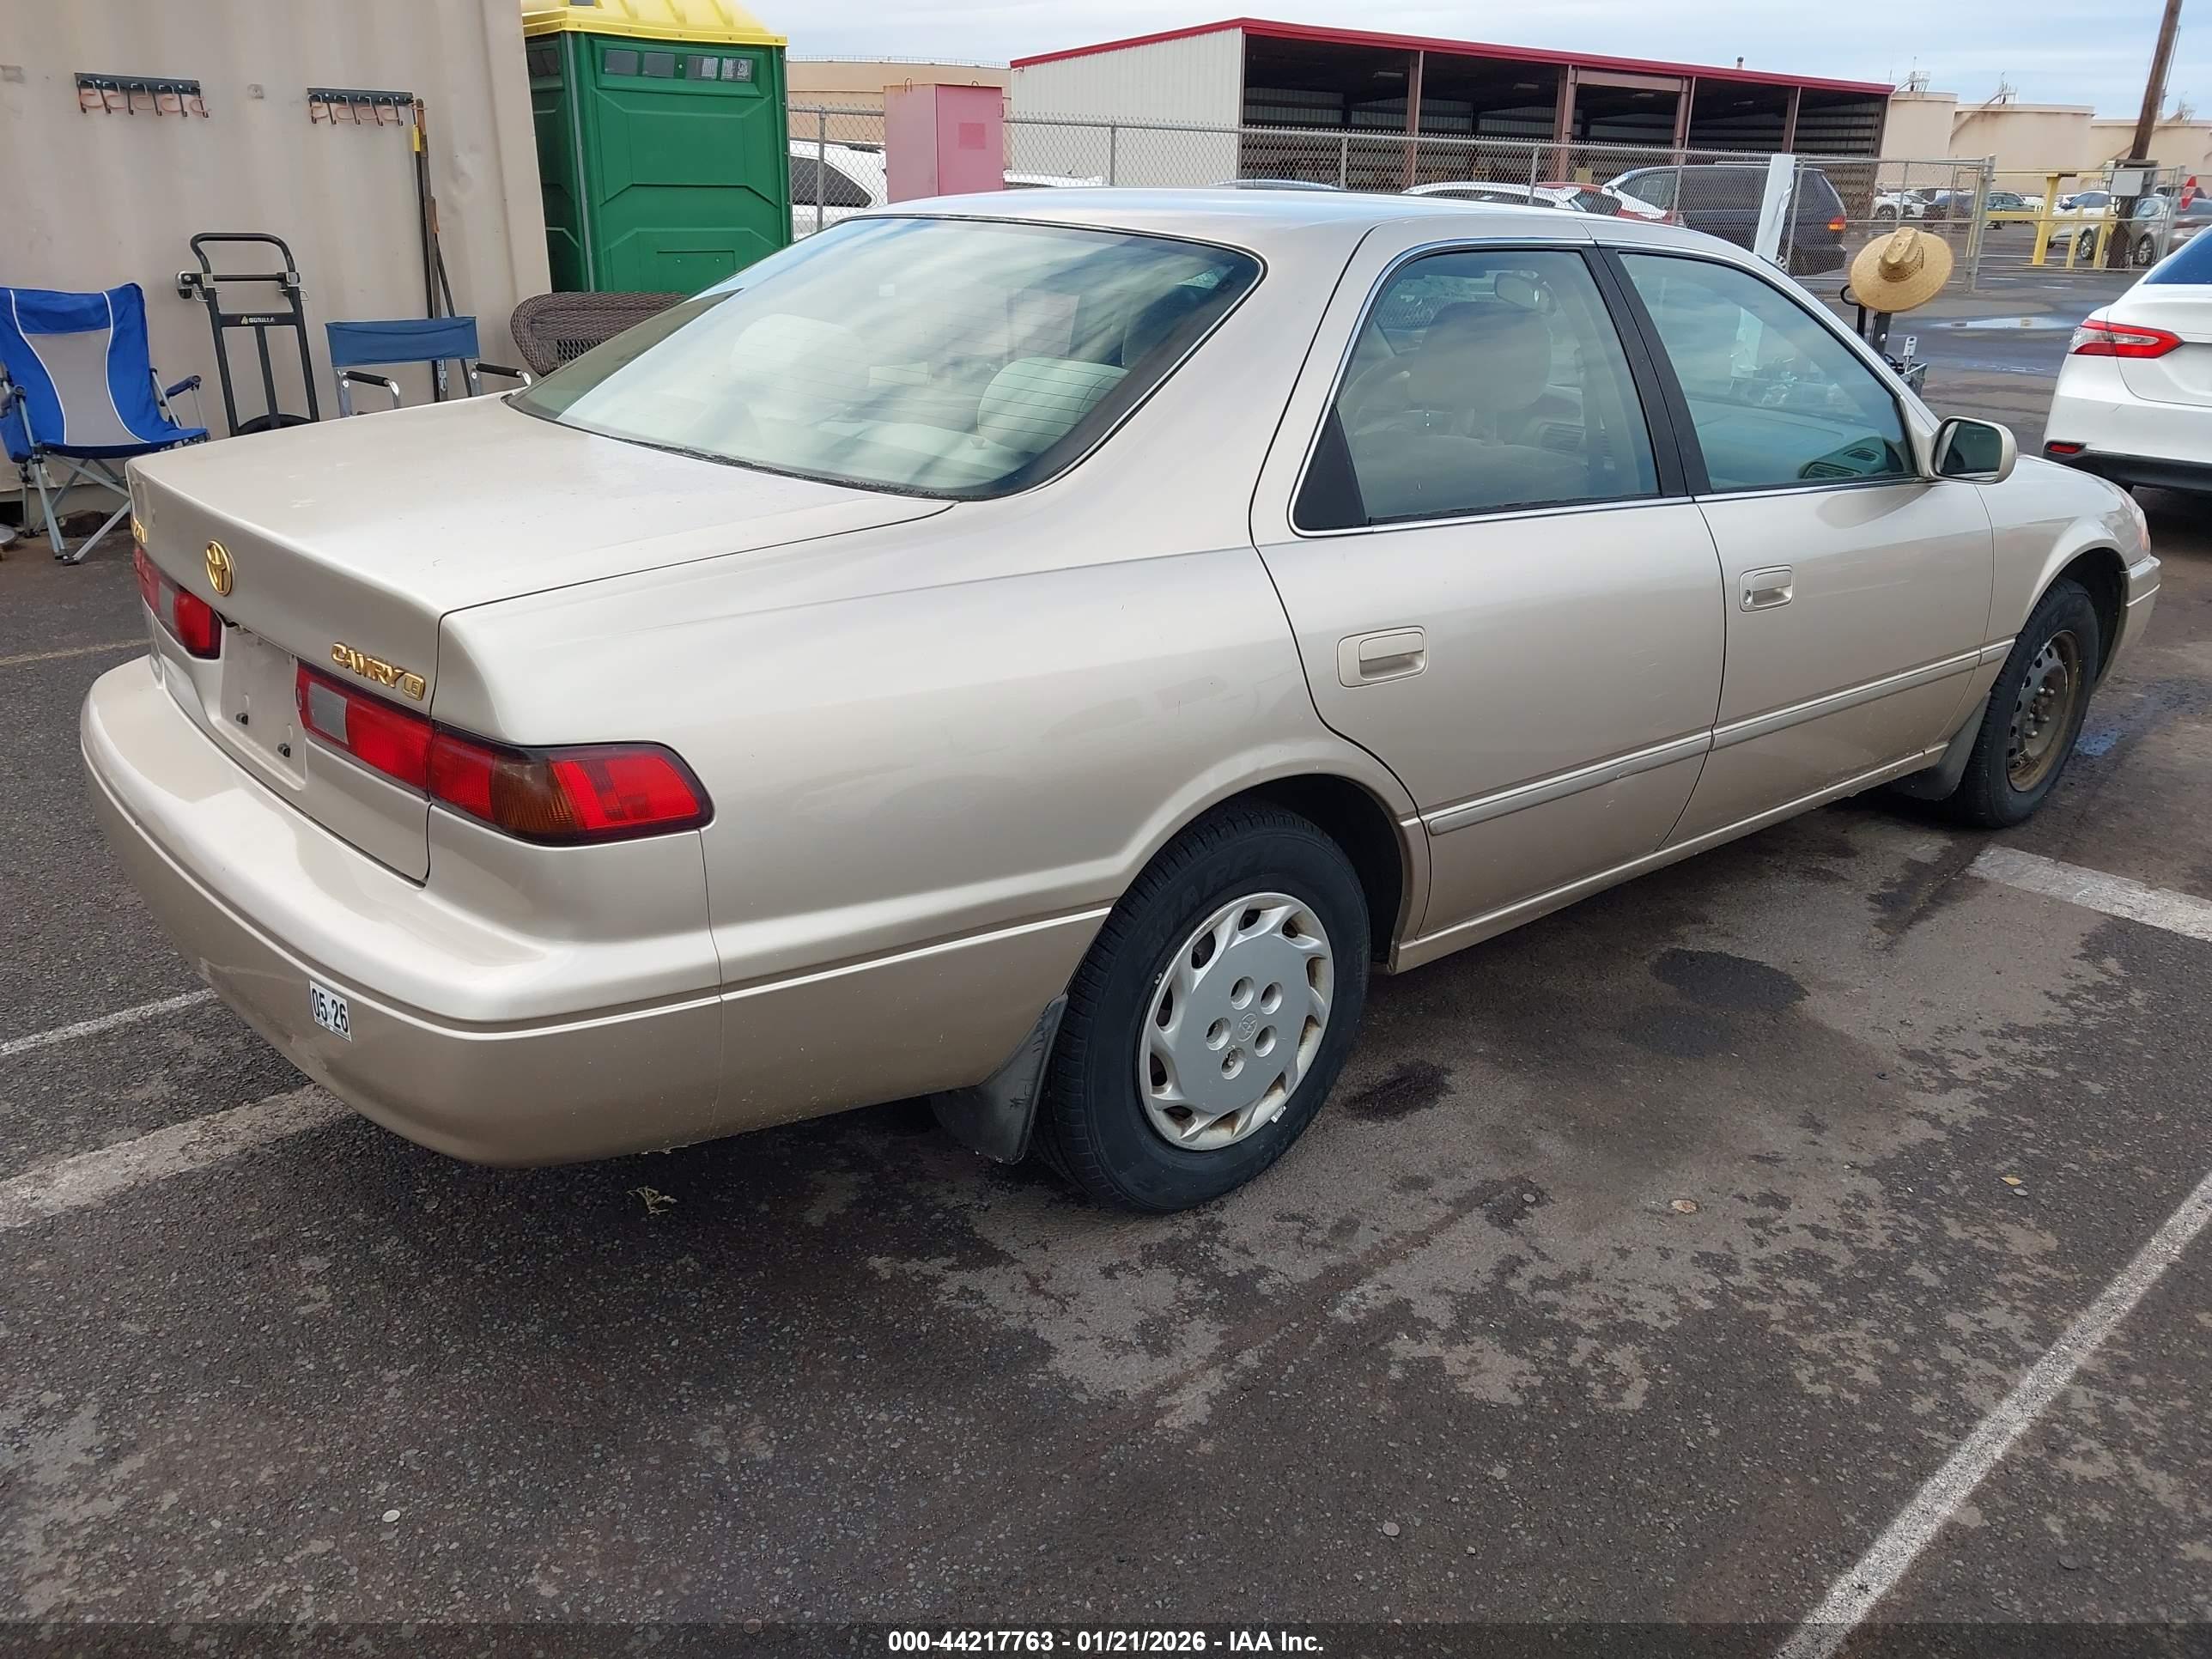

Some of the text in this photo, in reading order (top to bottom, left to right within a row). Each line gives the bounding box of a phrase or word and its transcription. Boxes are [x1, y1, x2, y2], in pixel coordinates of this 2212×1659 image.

[331, 642, 404, 689] CAMRY
[312, 988, 328, 1022] 05
[331, 999, 349, 1034] 26
